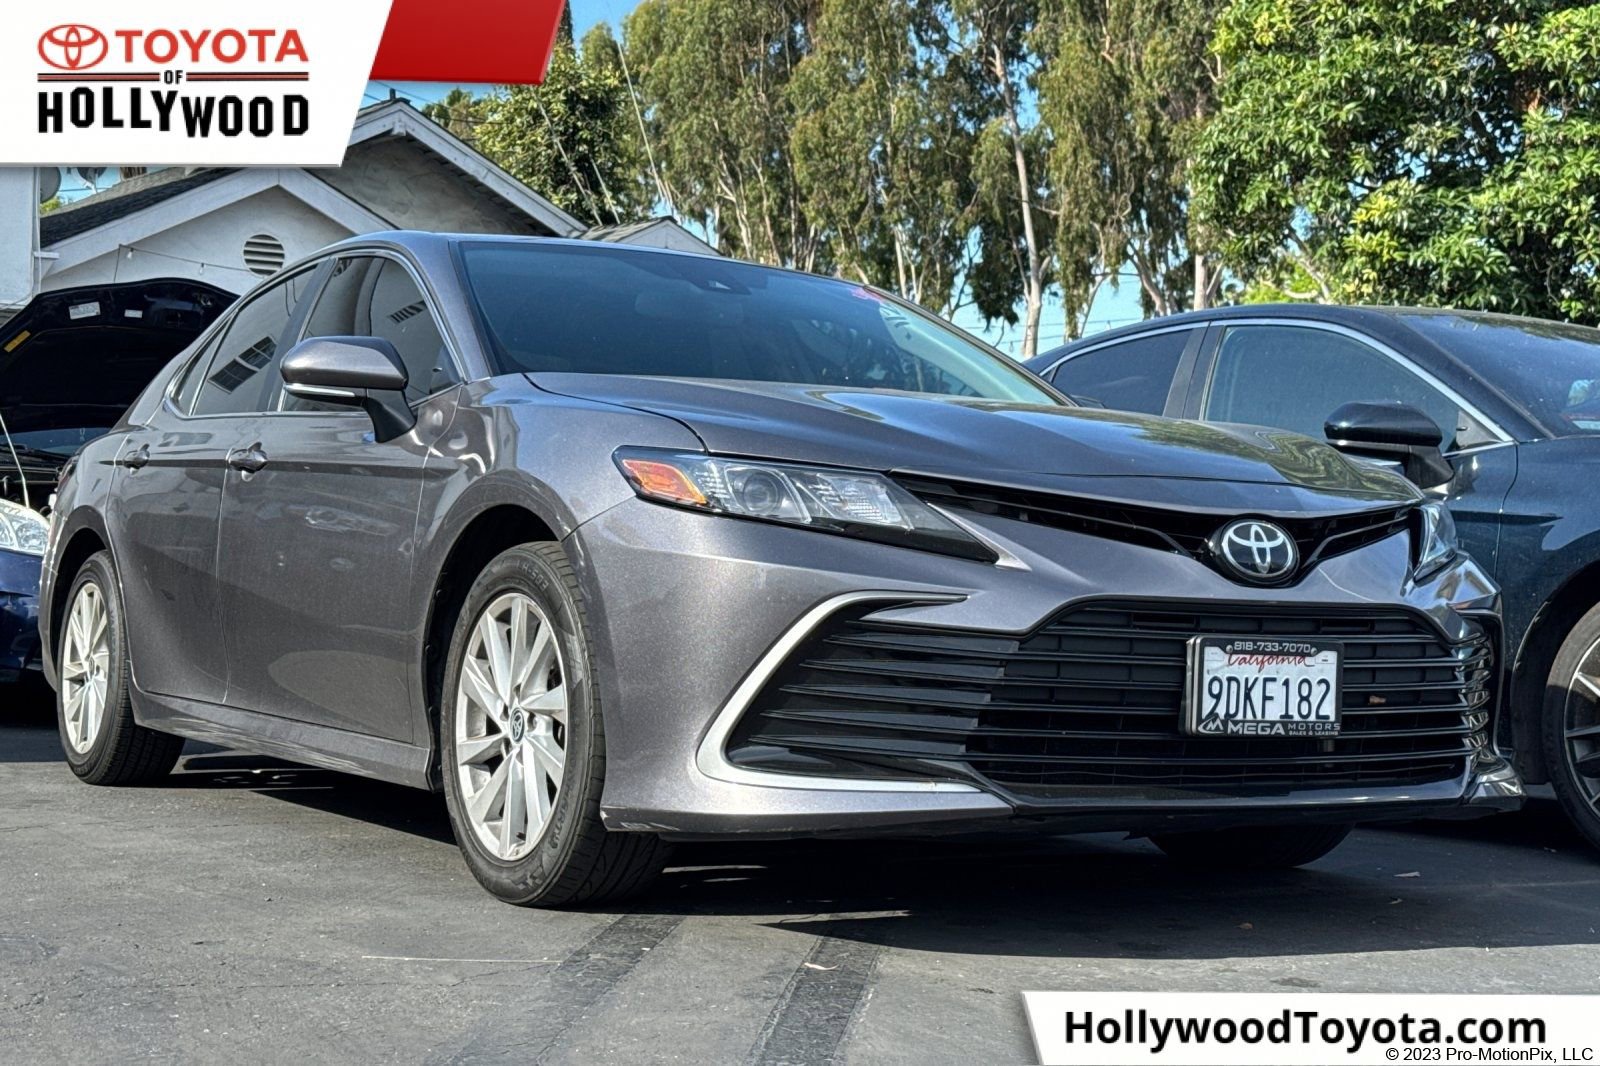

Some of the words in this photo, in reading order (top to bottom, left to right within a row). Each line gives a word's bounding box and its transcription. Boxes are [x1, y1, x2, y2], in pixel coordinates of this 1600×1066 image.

[1233, 641, 1311, 653] 818-733-7070
[1227, 653, 1315, 673] California
[1205, 675, 1331, 720] 9DKF182
[1227, 721, 1286, 736] MEGA
[1287, 722, 1341, 731] MOTORS
